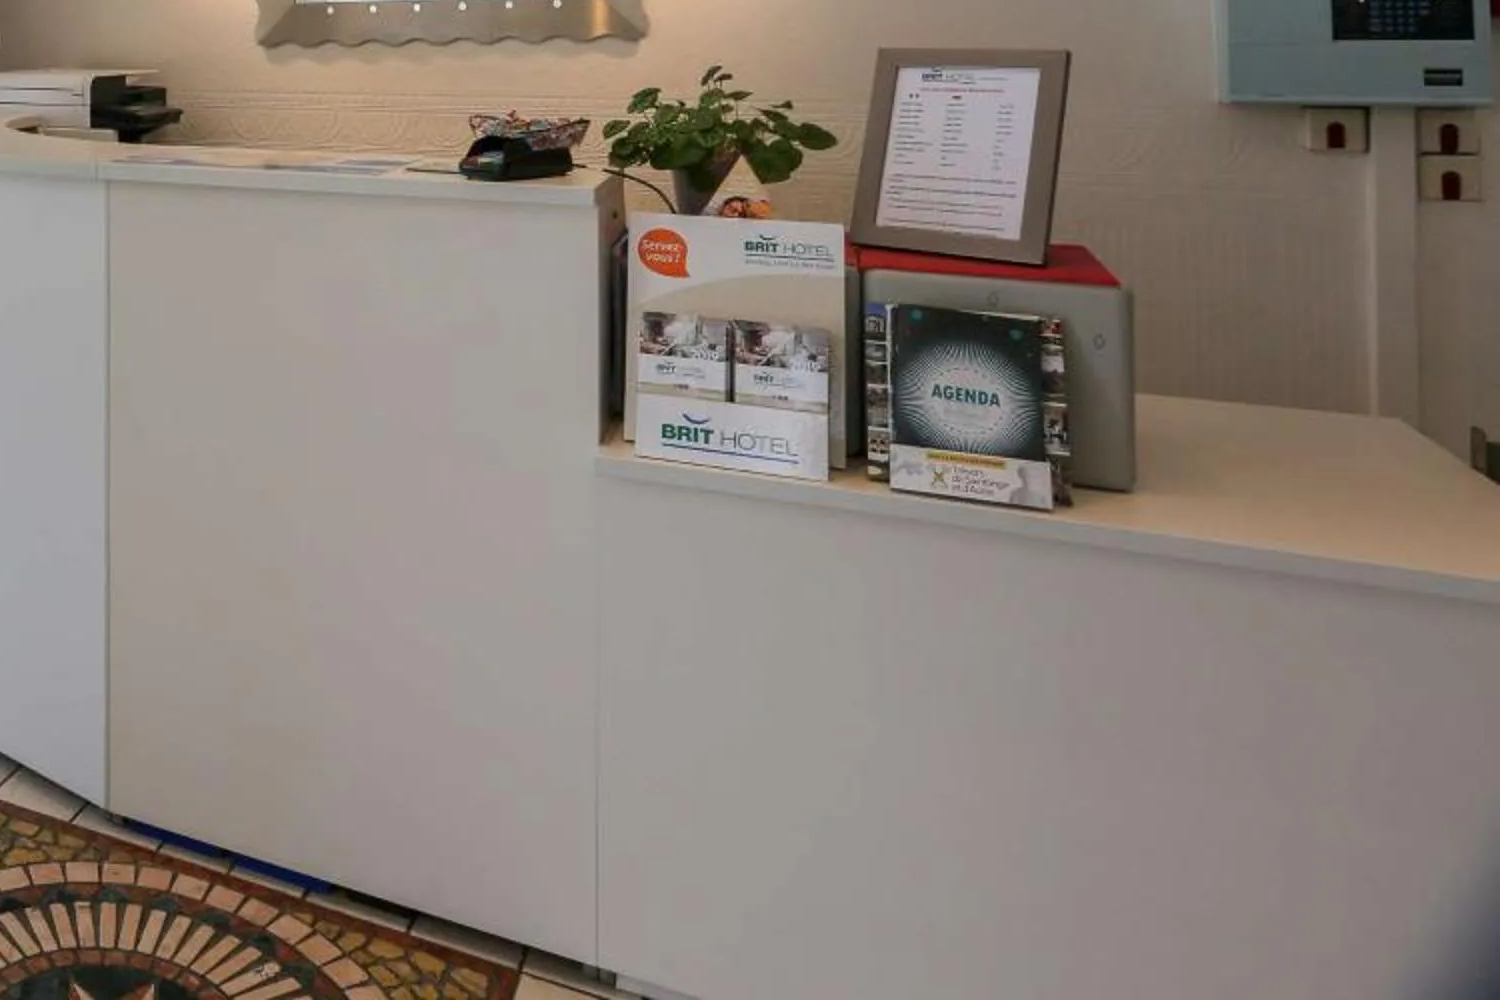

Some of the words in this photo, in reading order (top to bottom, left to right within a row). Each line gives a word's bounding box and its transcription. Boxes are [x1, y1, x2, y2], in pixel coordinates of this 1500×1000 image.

[743, 240, 779, 253] BRIT
[931, 383, 1002, 408] AGENDA
[660, 422, 715, 446] BRIT
[719, 431, 799, 458] HOTEL
